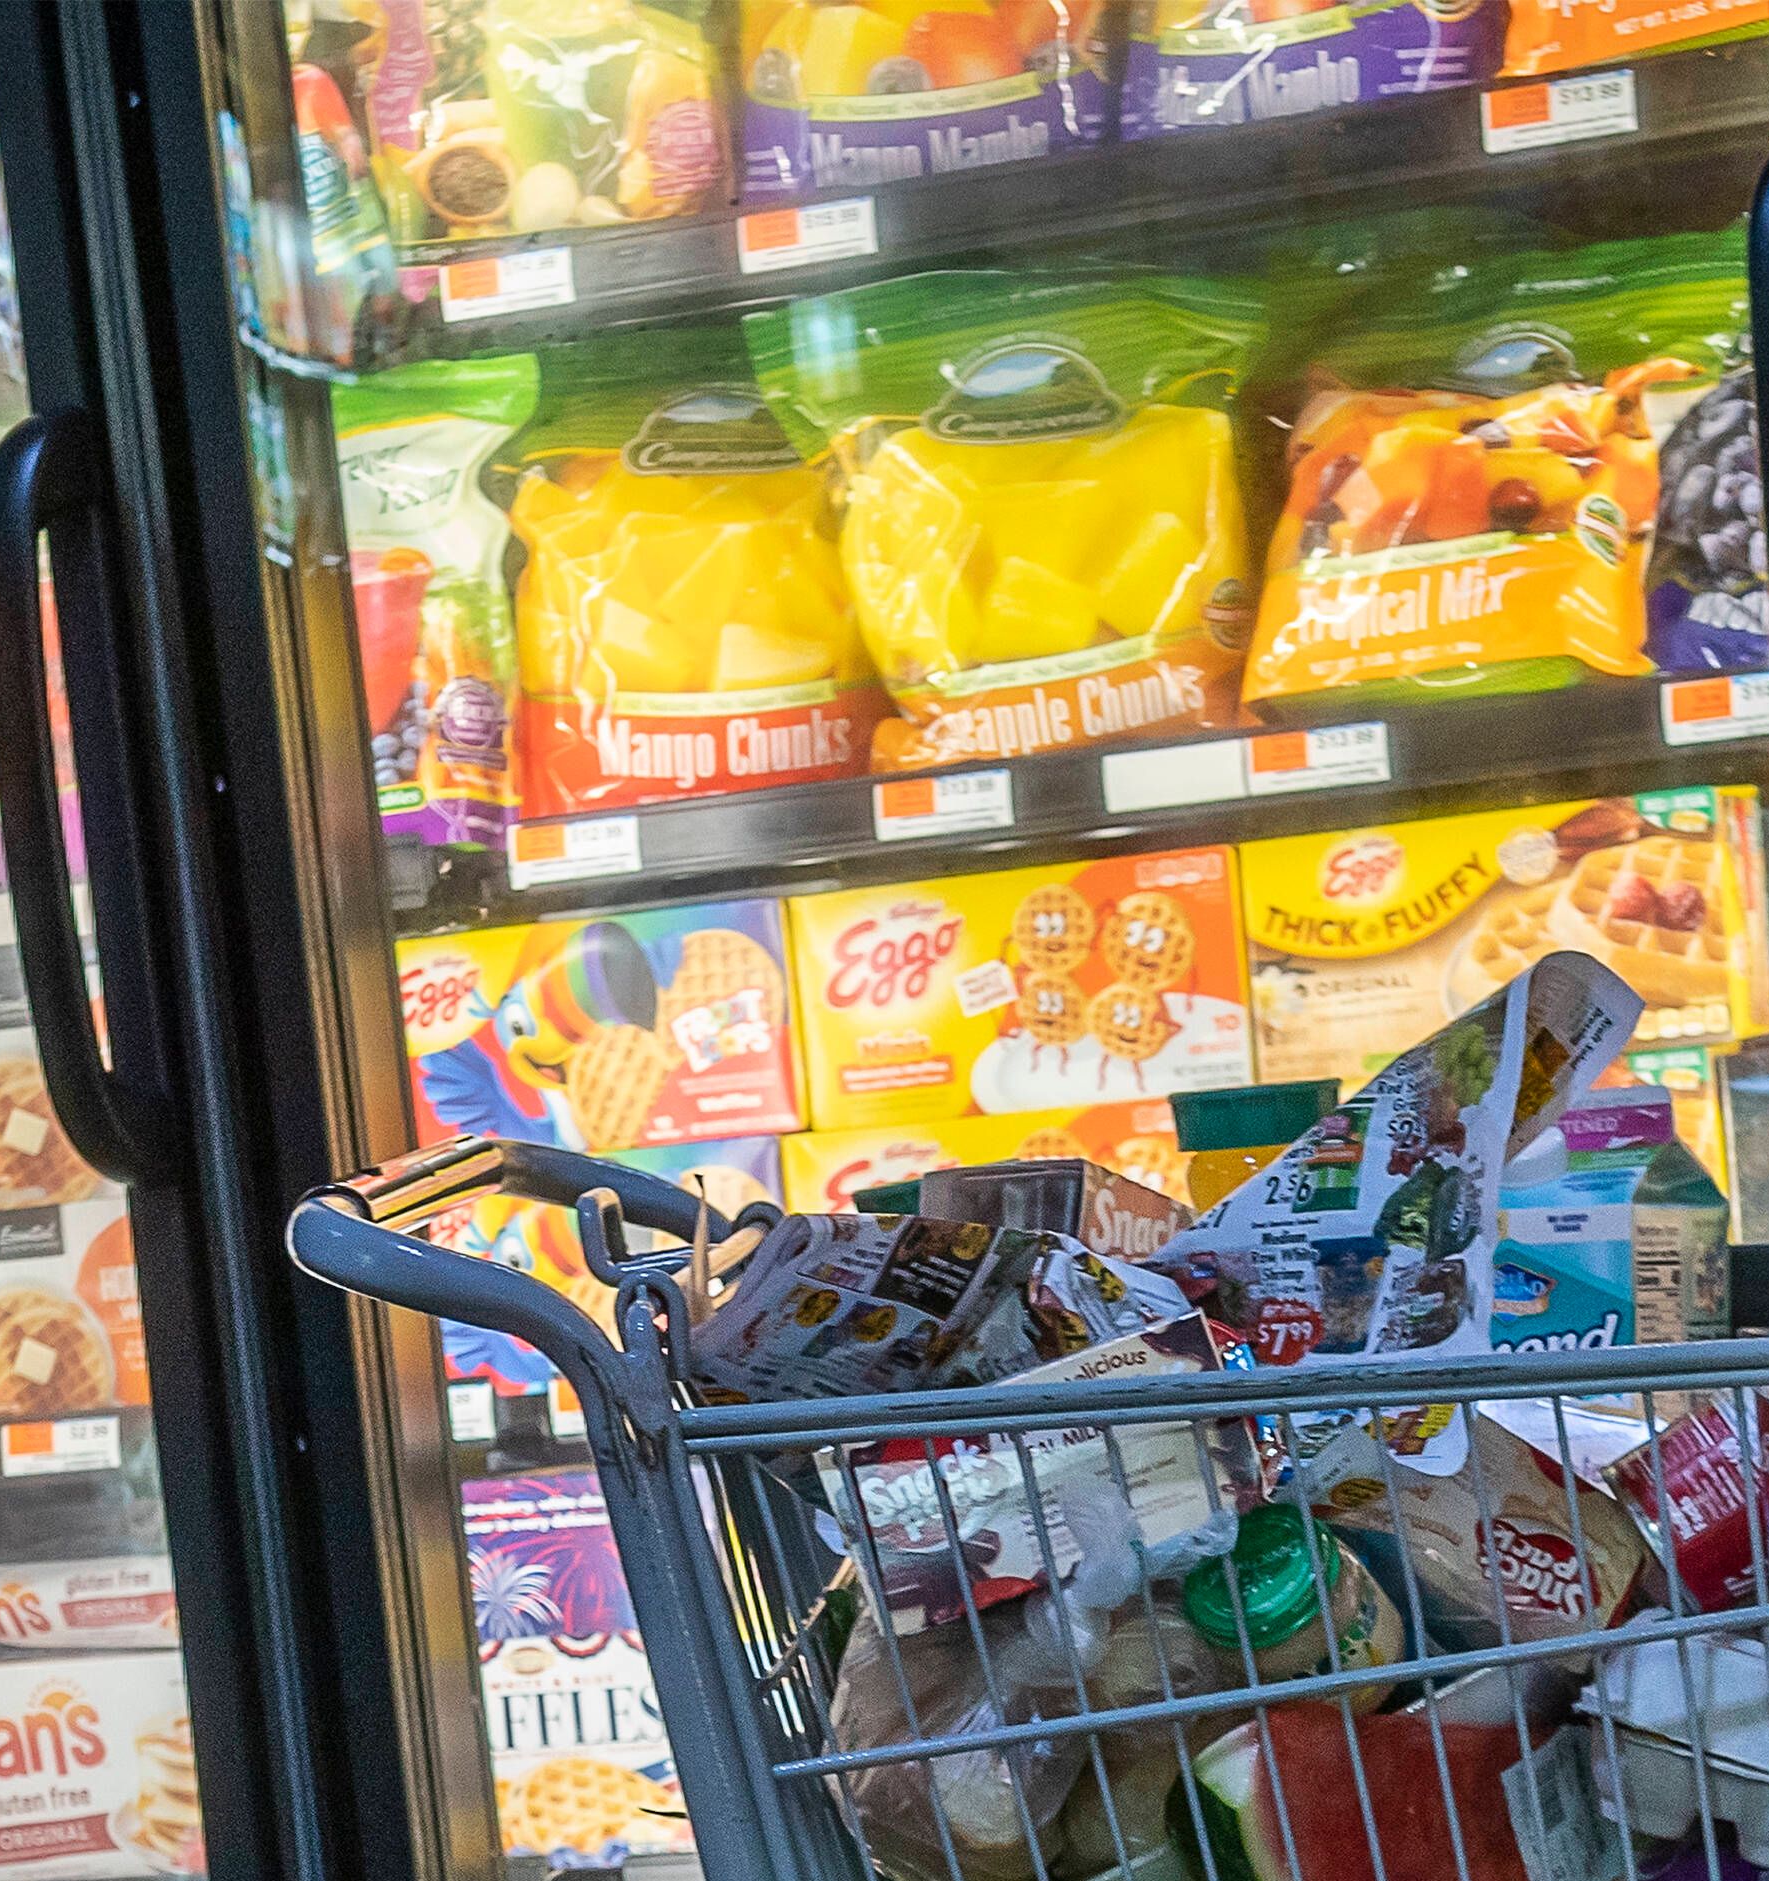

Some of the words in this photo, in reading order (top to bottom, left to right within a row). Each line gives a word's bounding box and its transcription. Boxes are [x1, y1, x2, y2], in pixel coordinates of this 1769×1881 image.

[1438, 556, 1509, 626] Mix
[1074, 660, 1207, 737] Chunks
[596, 716, 716, 789] Mango
[724, 707, 854, 777] Chunks
[1264, 907, 1358, 948] THICK
[1385, 851, 1492, 941] FLUFFY
[826, 915, 965, 1010] Eggo
[49, 1785, 92, 1810] free
